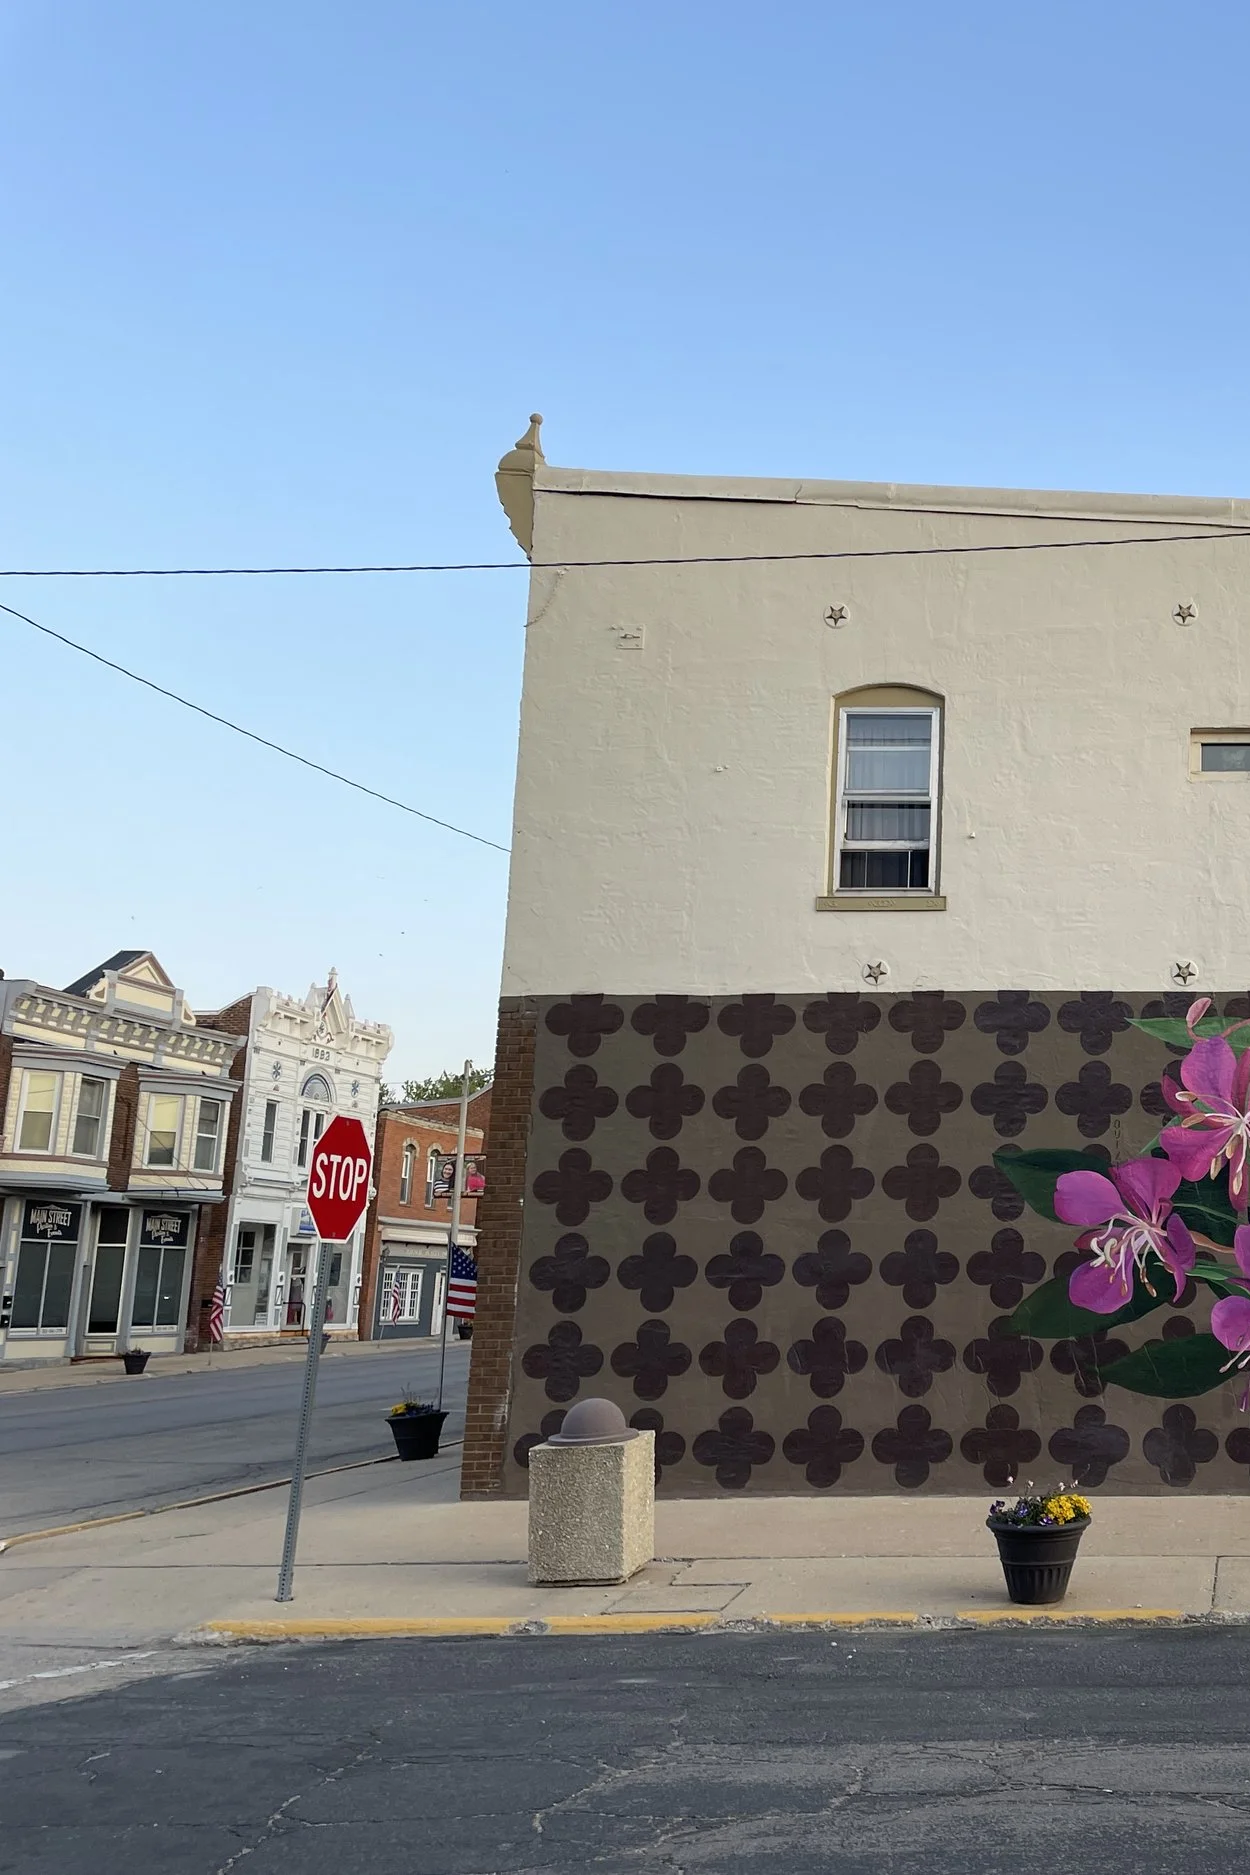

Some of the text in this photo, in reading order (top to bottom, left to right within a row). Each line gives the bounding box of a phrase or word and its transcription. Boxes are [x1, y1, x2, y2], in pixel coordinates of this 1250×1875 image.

[312, 1152, 368, 1201] STOP
[30, 1208, 72, 1227] MAIN STREET
[145, 1217, 181, 1234] MAIN STREET
